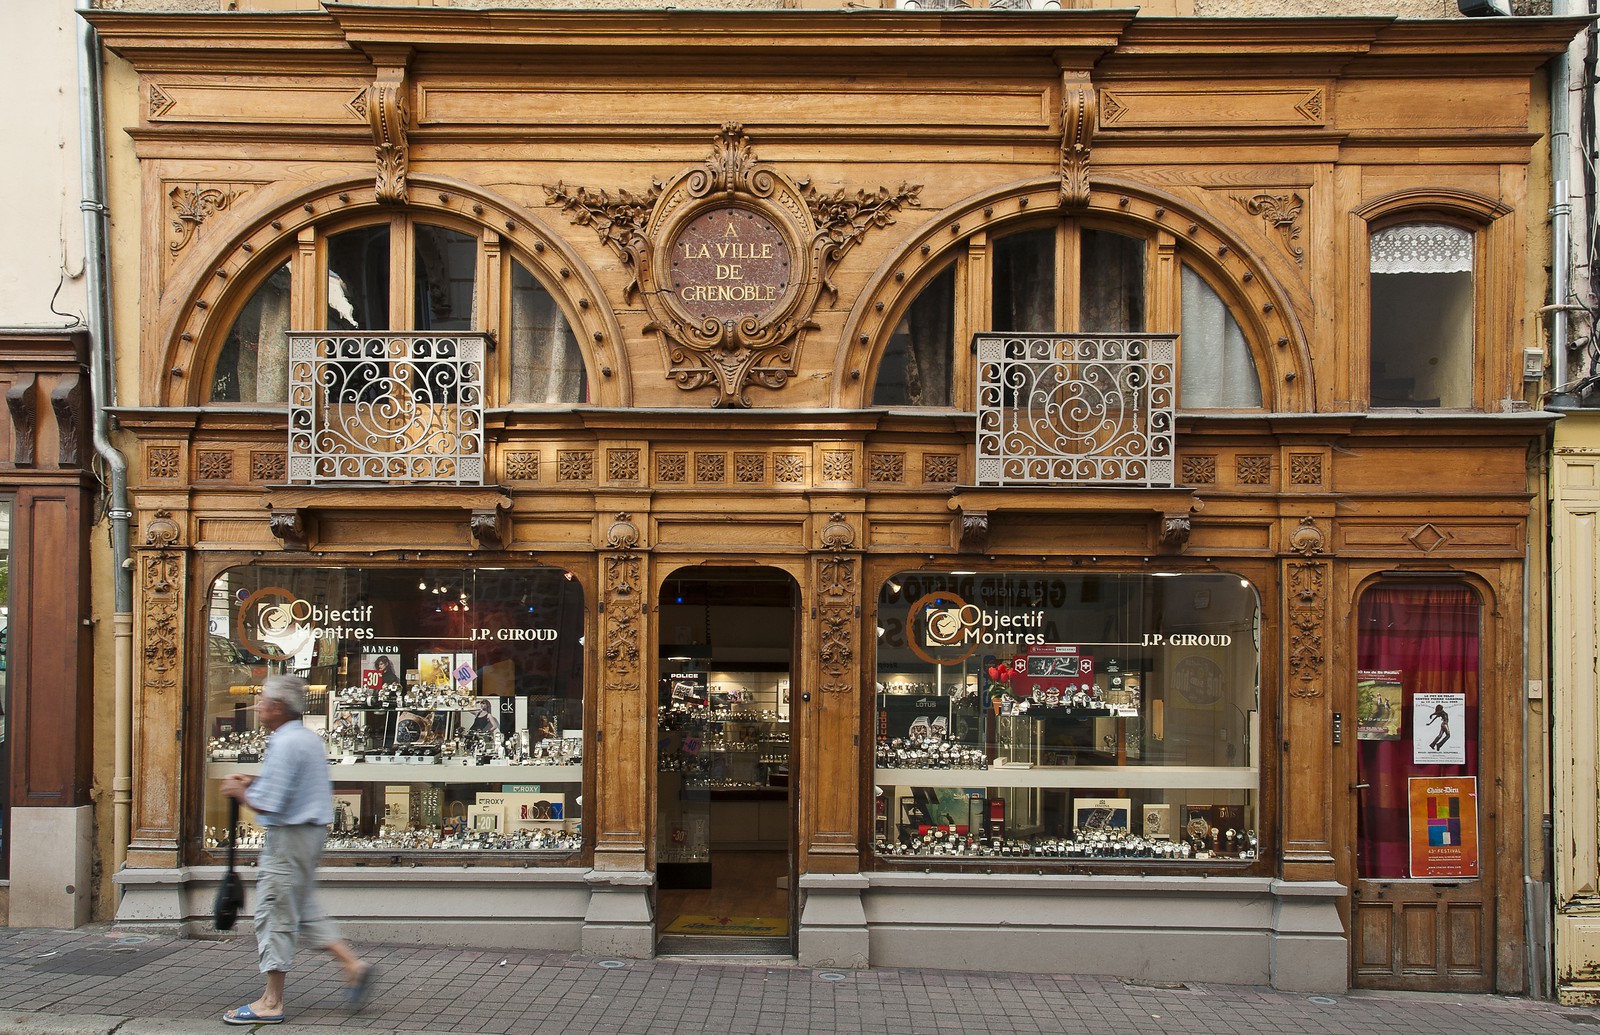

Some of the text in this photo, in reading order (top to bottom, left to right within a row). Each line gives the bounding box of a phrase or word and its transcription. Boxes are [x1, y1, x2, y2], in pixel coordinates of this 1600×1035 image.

[724, 222, 738, 237] A
[684, 243, 774, 259] LA VILLE
[715, 264, 744, 280] DE
[681, 285, 776, 301] GRENOBLE
[290, 599, 374, 625] Objectif
[959, 604, 1045, 631] Objectif
[295, 622, 375, 640] Montres
[469, 628, 558, 641] J.P. GIROUD
[963, 627, 1046, 645] Montres
[1141, 633, 1232, 647] J.P. GIROUD
[362, 645, 399, 653] MANGO
[500, 697, 514, 711] ck
[520, 803, 563, 819] ROXY
